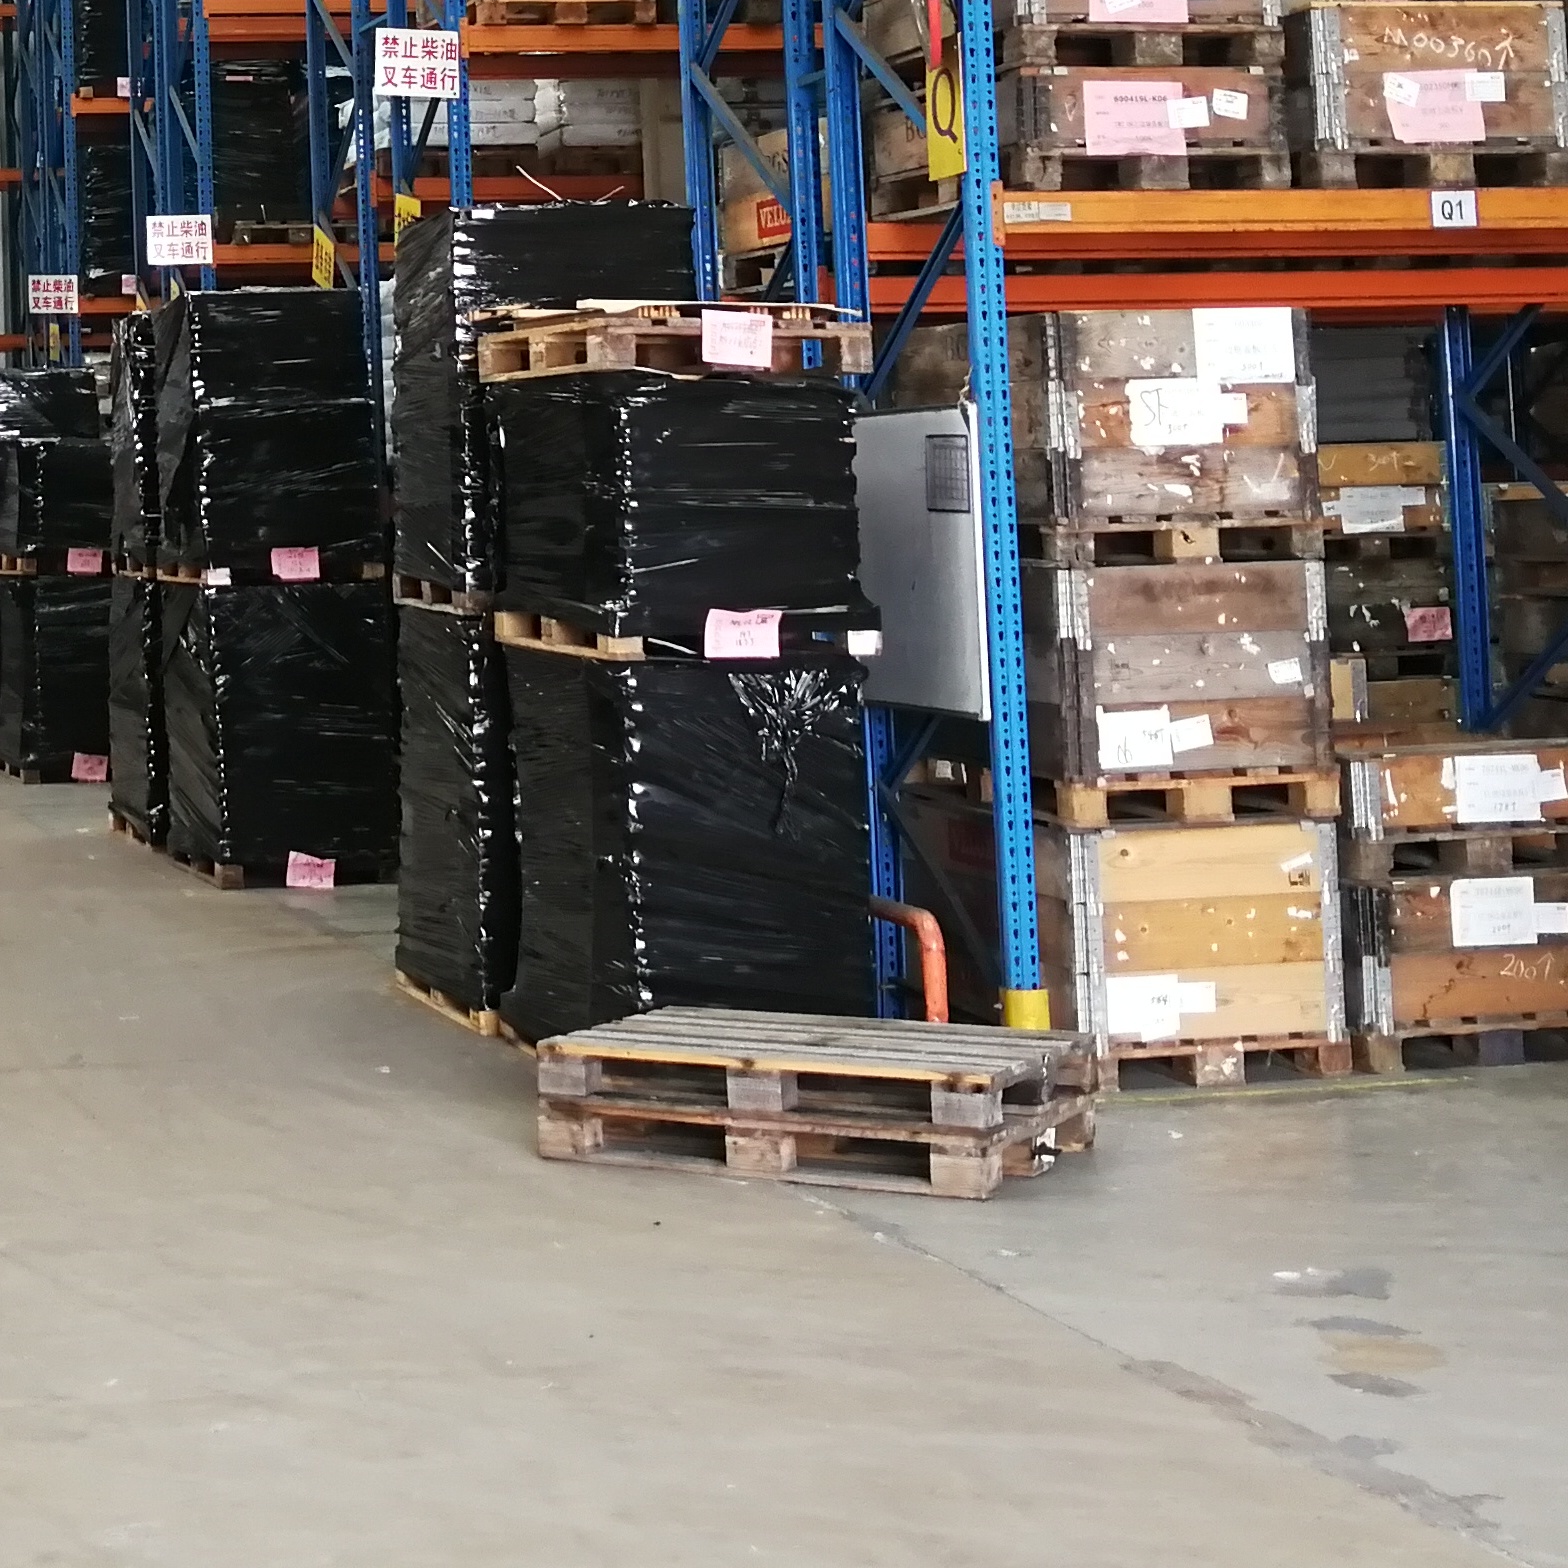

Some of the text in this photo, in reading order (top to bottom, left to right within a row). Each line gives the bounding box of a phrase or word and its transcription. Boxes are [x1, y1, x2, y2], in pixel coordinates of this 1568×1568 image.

[381, 35, 458, 62] 禁止柴油
[381, 65, 458, 92] 叉车通行
[931, 66, 959, 144] Q
[1441, 199, 1464, 221] Q1
[151, 220, 208, 239] 禁止柴油
[152, 241, 209, 260] 叉车通行
[31, 279, 74, 293] 禁止柴油
[31, 295, 74, 311] 叉车通行
